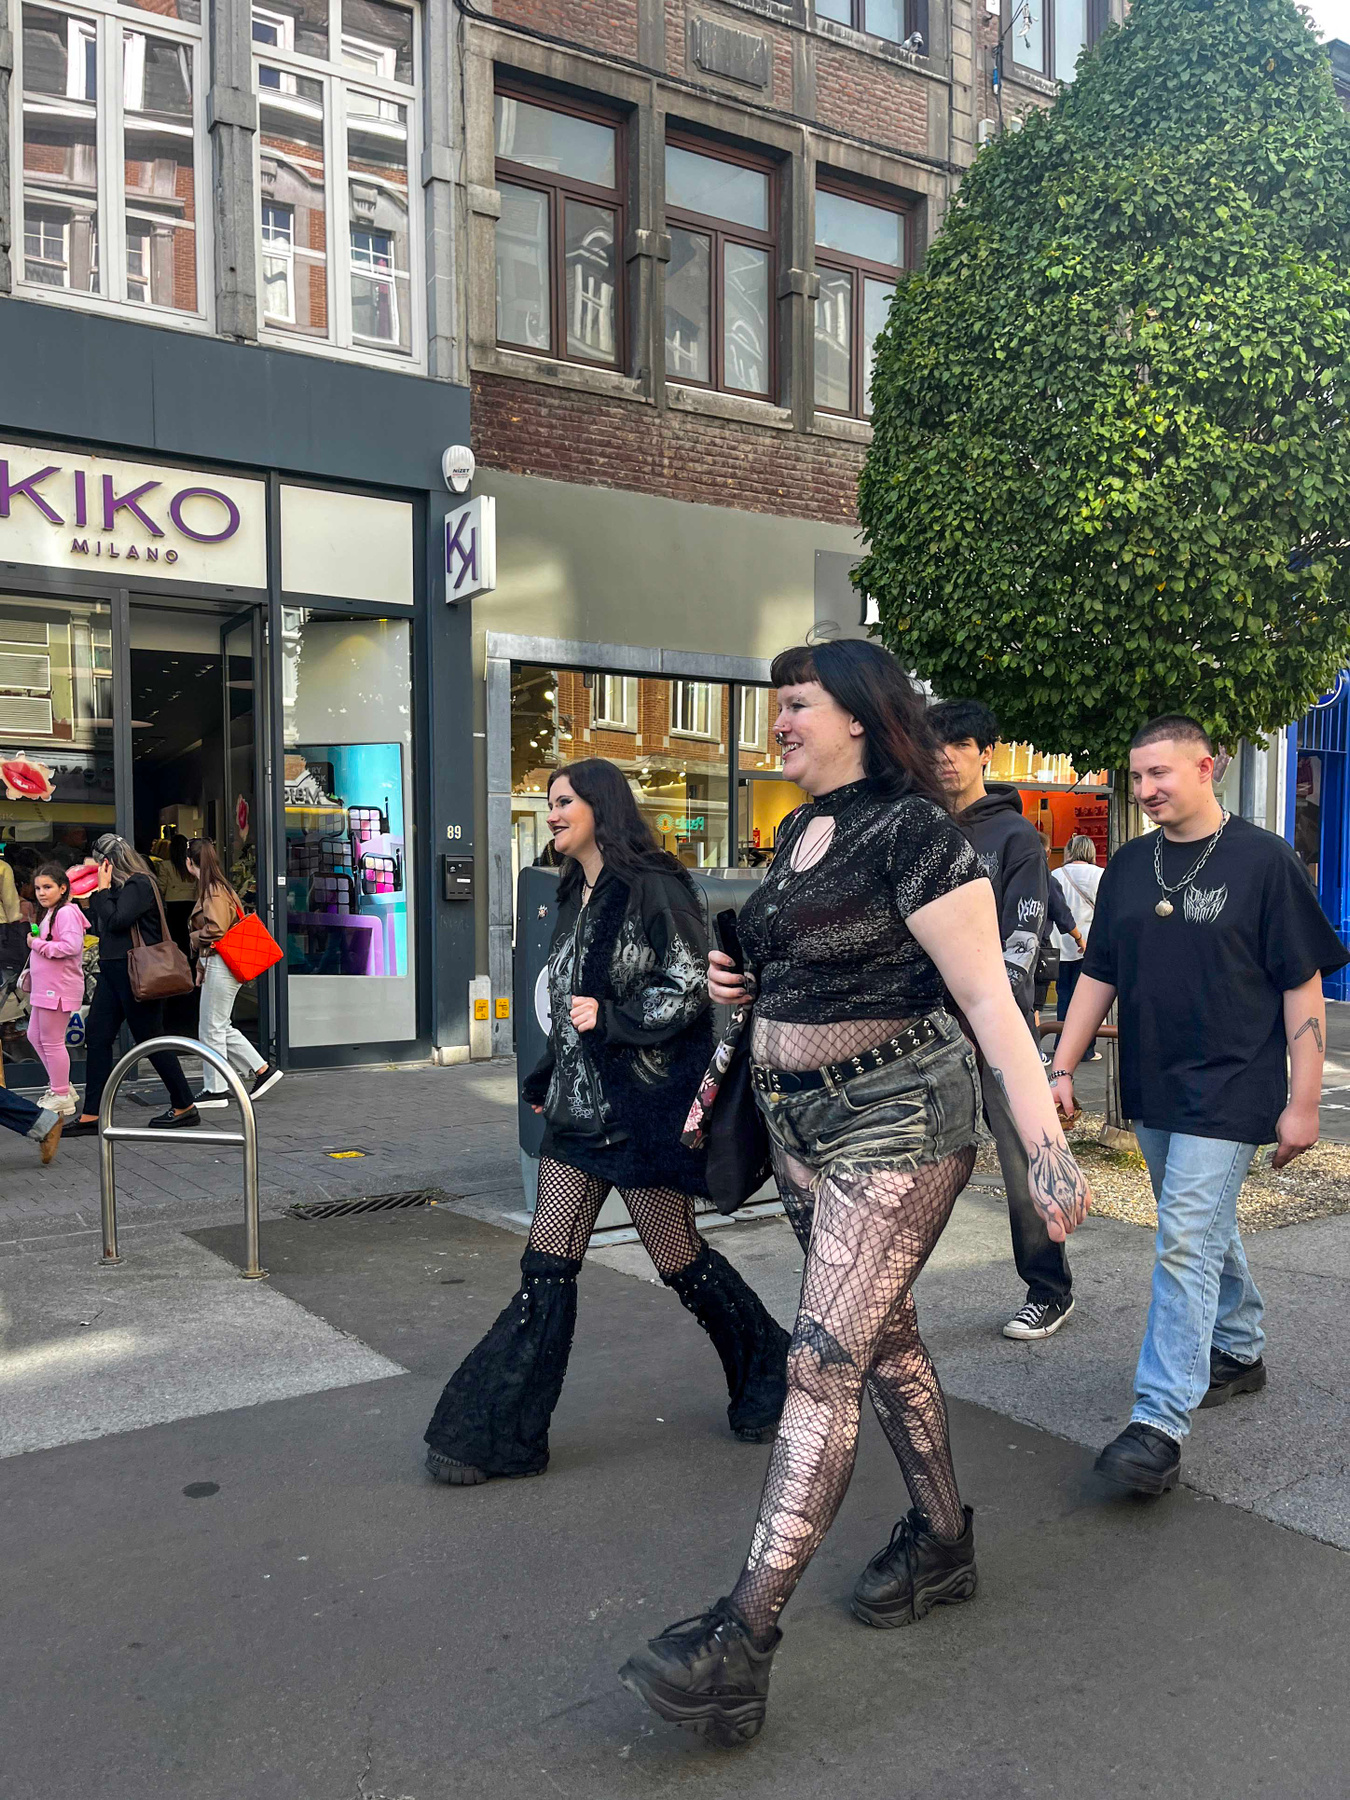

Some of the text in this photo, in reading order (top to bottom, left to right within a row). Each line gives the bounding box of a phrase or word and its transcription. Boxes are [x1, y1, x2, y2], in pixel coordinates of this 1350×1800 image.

[0, 459, 241, 543] KIKO
[70, 538, 179, 565] MILANO
[447, 825, 462, 840] 89
